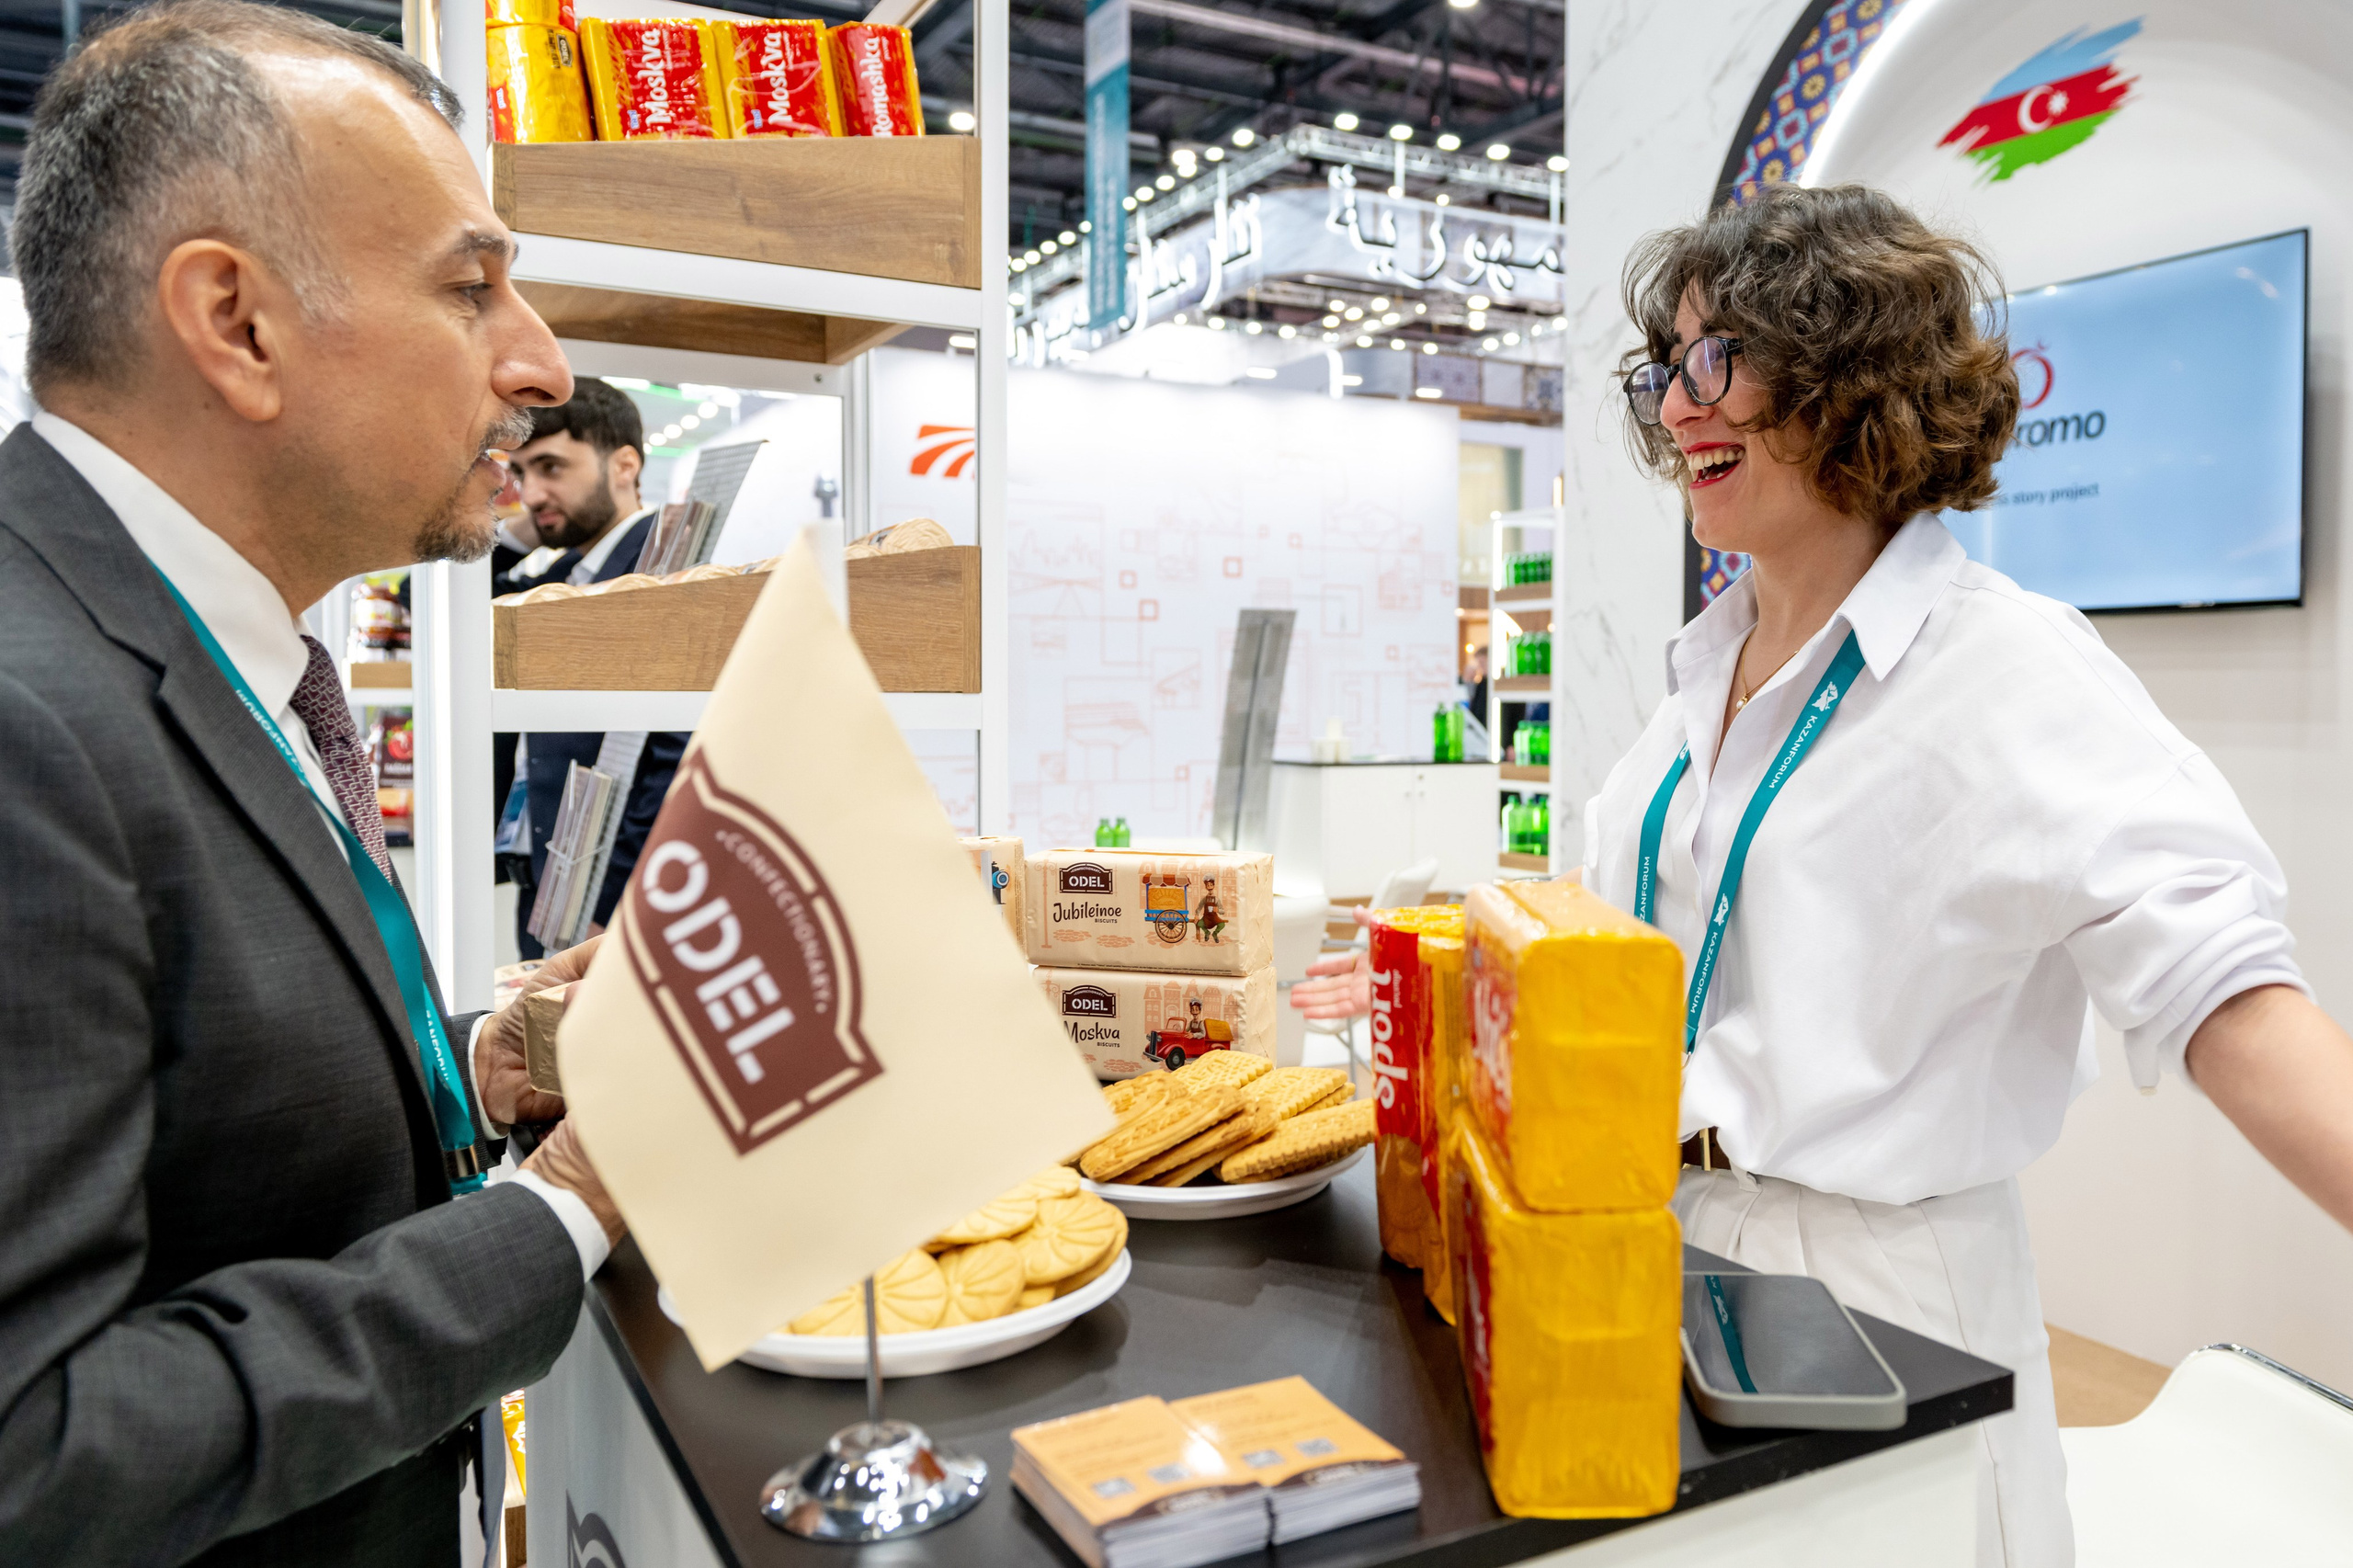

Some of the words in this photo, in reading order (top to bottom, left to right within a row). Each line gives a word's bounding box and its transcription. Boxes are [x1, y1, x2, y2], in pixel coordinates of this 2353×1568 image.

[638, 28, 674, 126] Moskva
[760, 30, 792, 126] Moskva
[859, 36, 893, 136] Romashka
[2015, 409, 2106, 449] romo
[1768, 715, 1818, 790] KAZANFORUM
[1052, 901, 1122, 923] Jubileinoe
[1068, 875, 1105, 888] ODEL
[642, 839, 795, 1085] ODEL
[1689, 931, 1718, 1014] KAZANFORUM
[1063, 1020, 1120, 1044] Moskva
[1071, 998, 1108, 1011] ODEL
